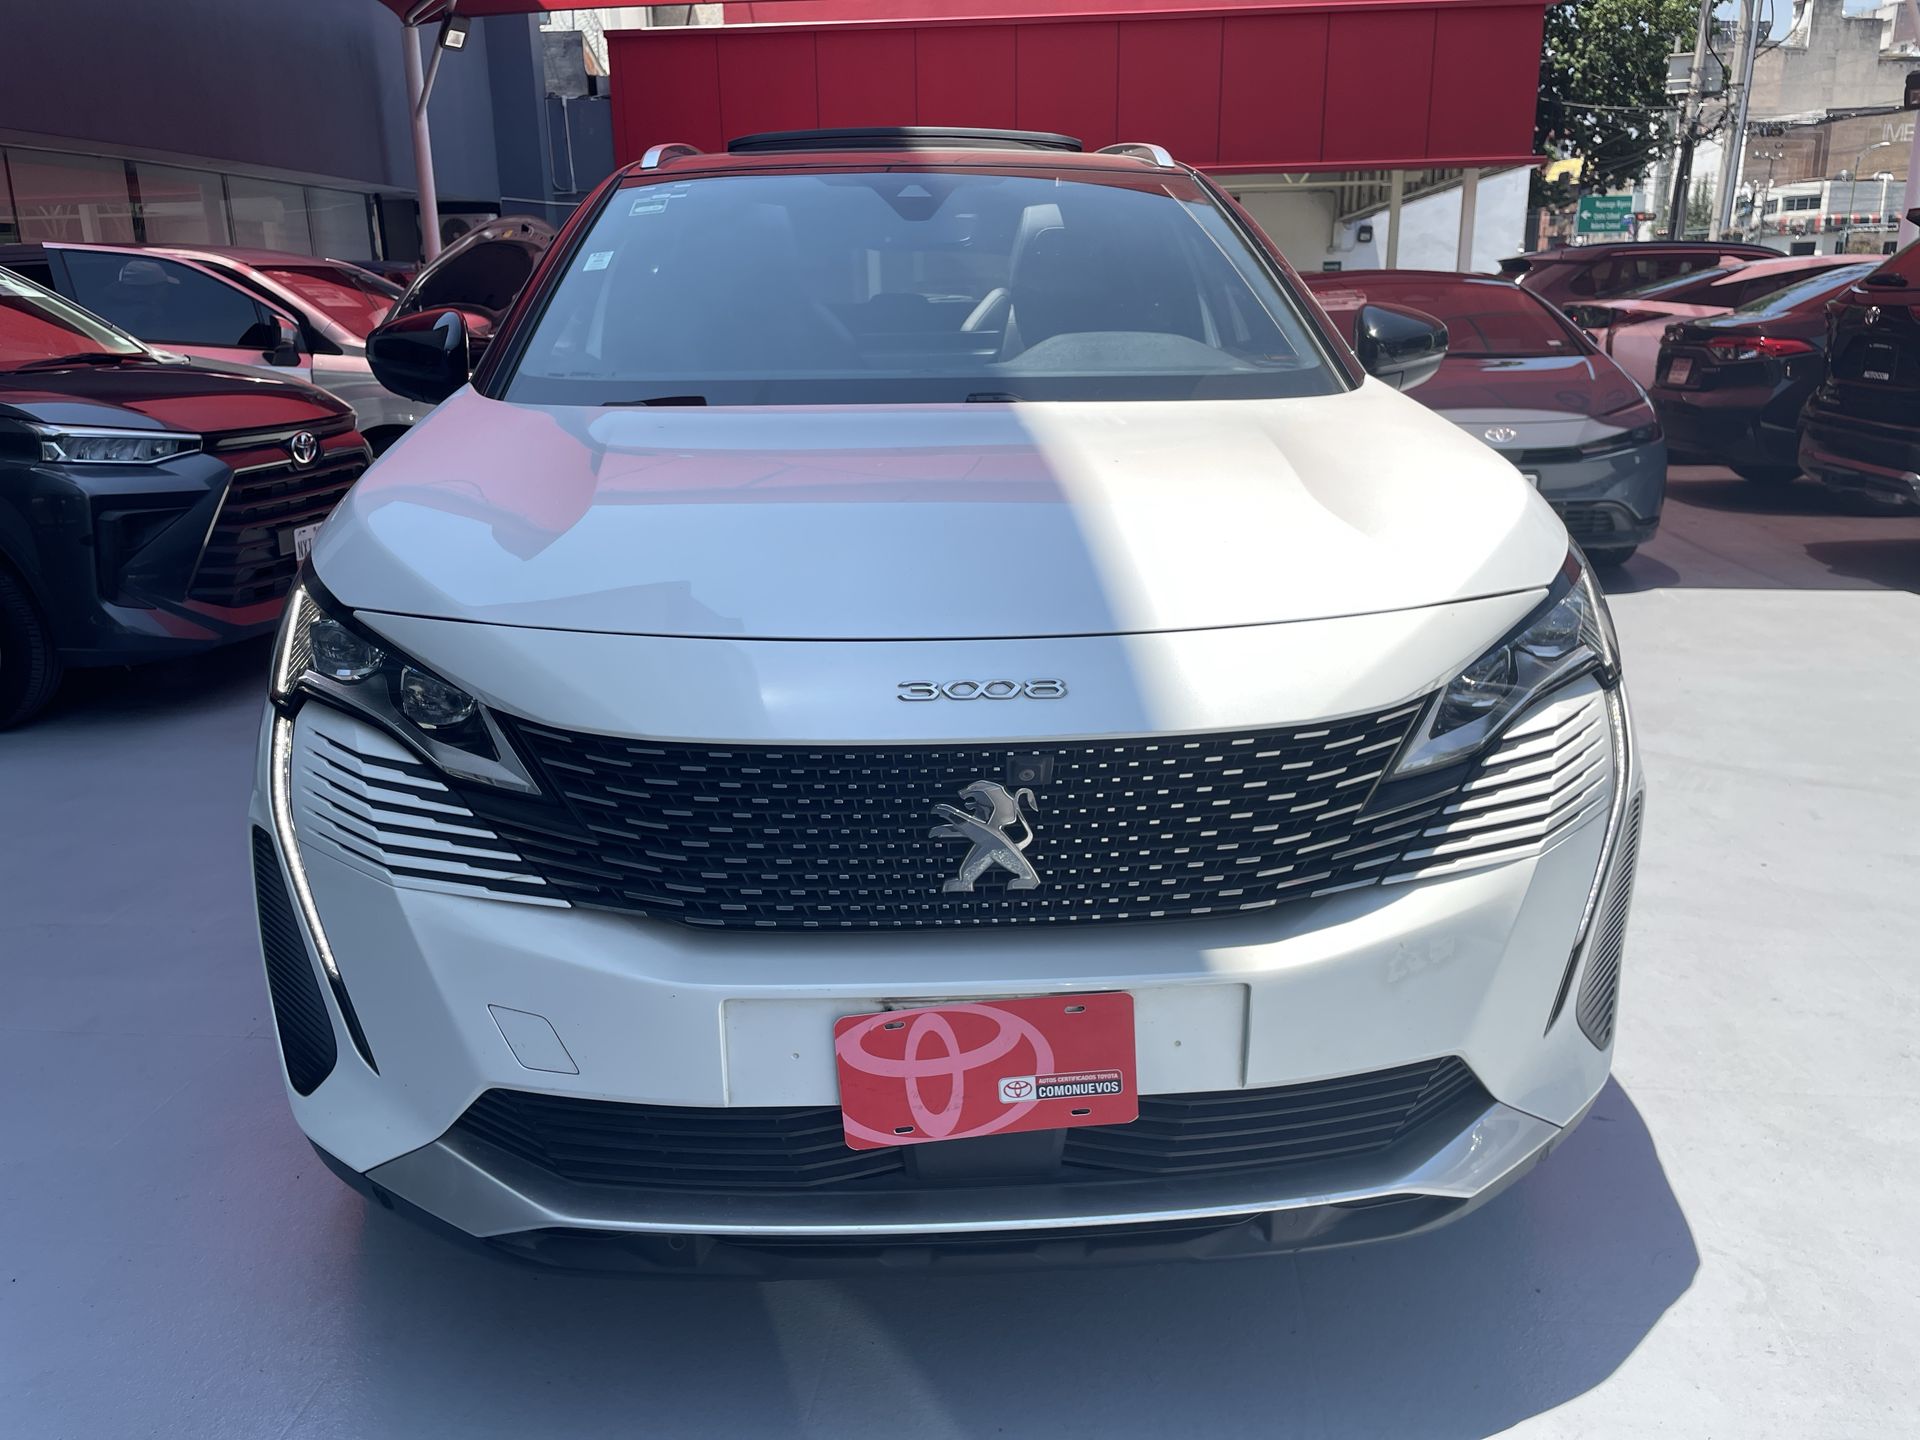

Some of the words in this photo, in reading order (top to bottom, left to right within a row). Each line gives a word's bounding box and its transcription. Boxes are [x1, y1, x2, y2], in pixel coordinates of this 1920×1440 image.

[897, 678, 1067, 701] 3008
[1058, 1074, 1096, 1082] CERTIFICADOS
[1038, 1081, 1119, 1097] COMONUEVOS
